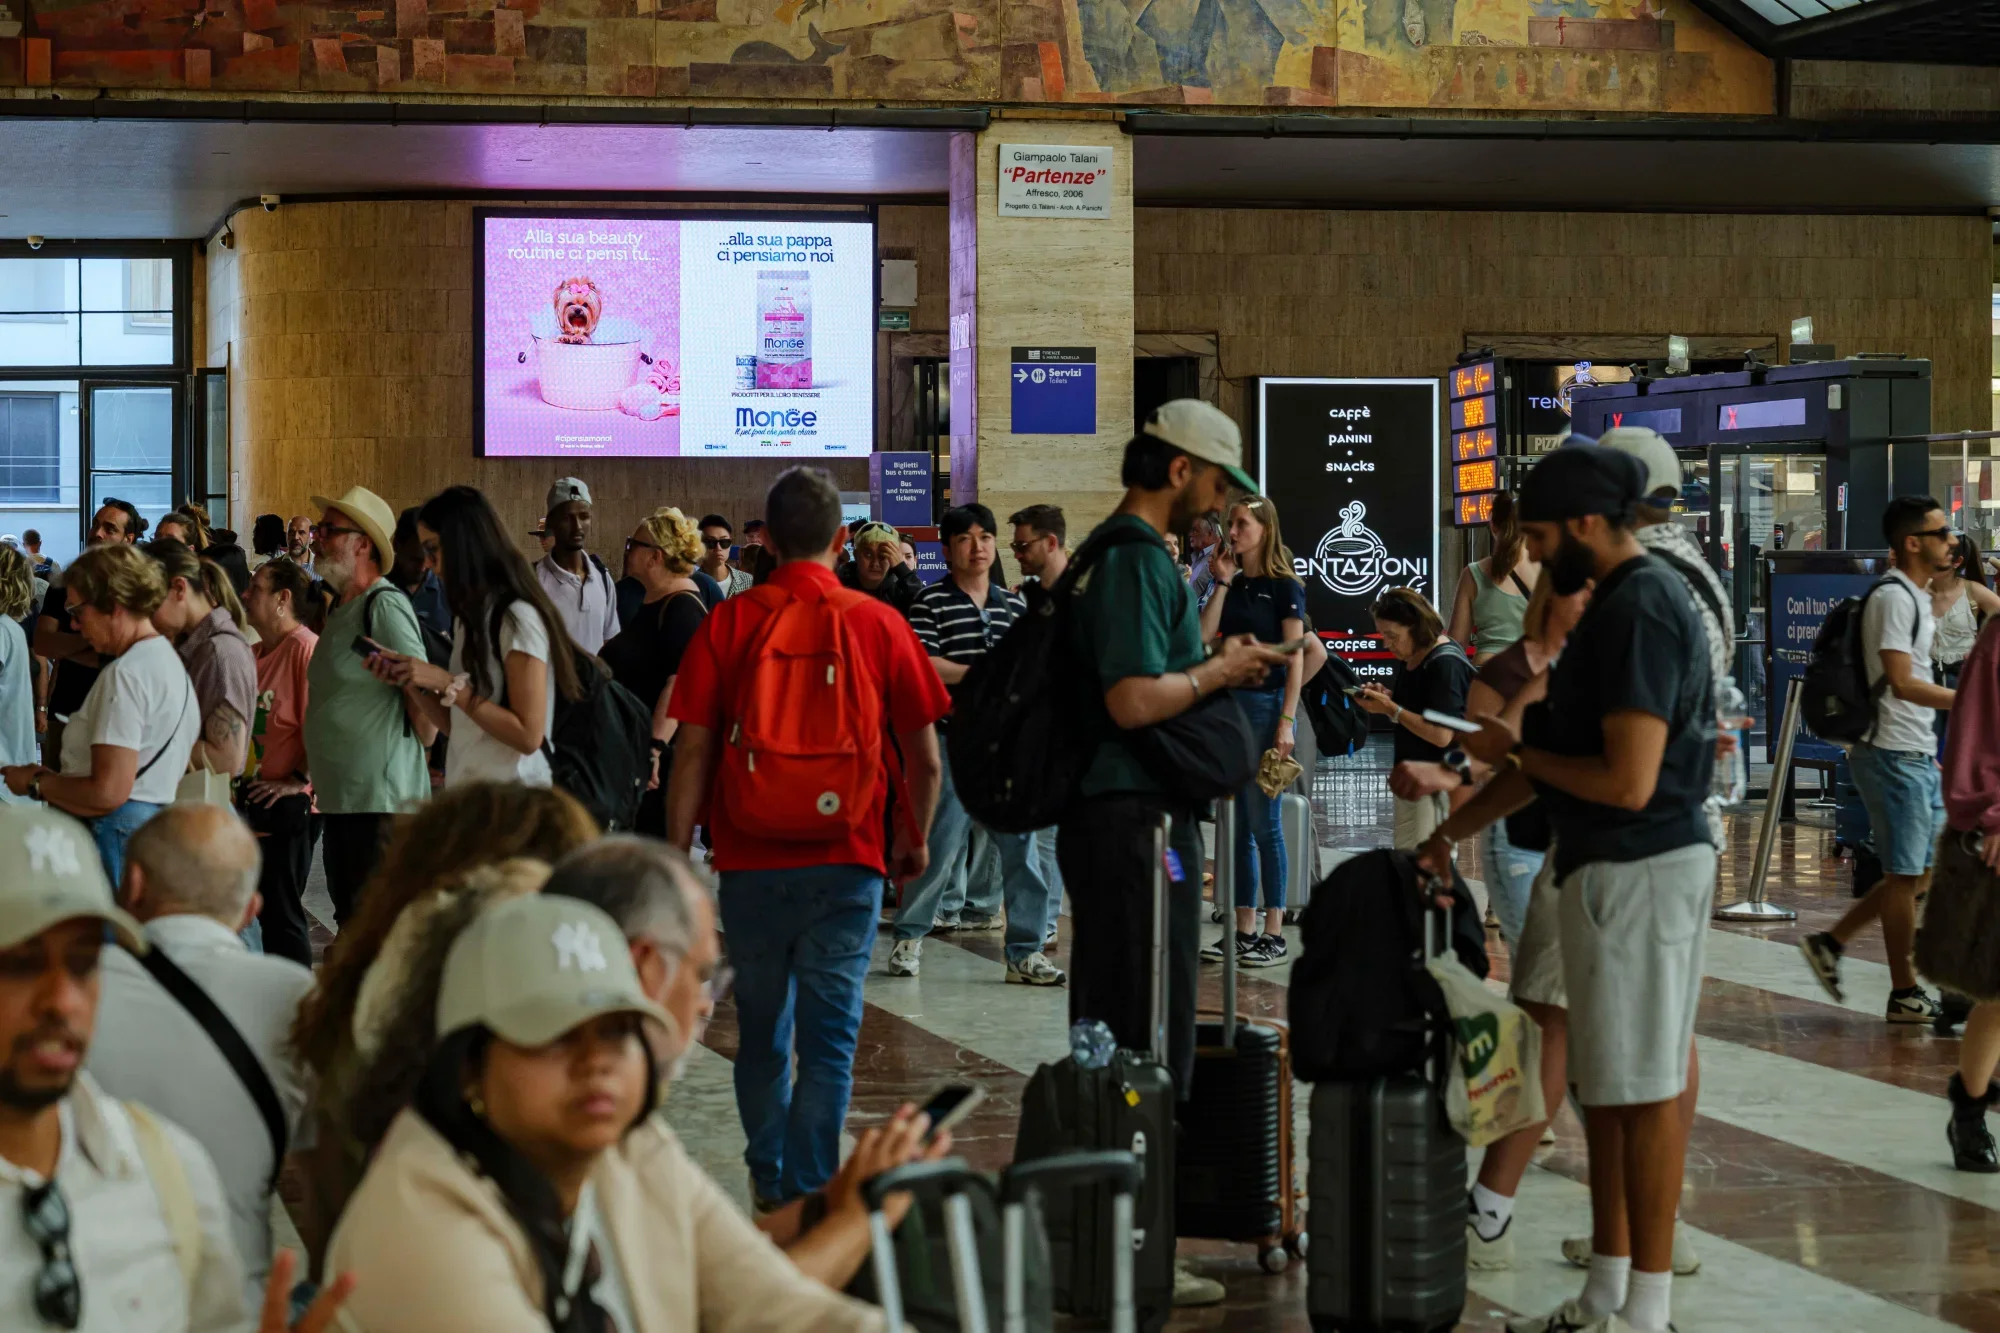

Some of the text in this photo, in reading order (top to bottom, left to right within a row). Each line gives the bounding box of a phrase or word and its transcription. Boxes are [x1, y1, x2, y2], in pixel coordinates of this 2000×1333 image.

[1013, 152, 1098, 163] Giampaolo Talani
[1026, 189, 1084, 198] Affresco, 2006
[1005, 202, 1030, 210] Progetto:
[524, 229, 643, 247] Alla sua beauty
[757, 235, 783, 246] sua
[786, 236, 832, 249] pappa
[508, 246, 658, 263] routine ci pensi tu...
[717, 248, 834, 264] ci pensiamo noi
[1049, 368, 1082, 377] Servizi
[893, 461, 919, 470] Biglietti
[895, 494, 917, 502] tickets
[1786, 596, 1804, 615] Con
[1805, 596, 1811, 615] il
[1813, 598, 1828, 616] tuo
[1787, 620, 1796, 640] ci
